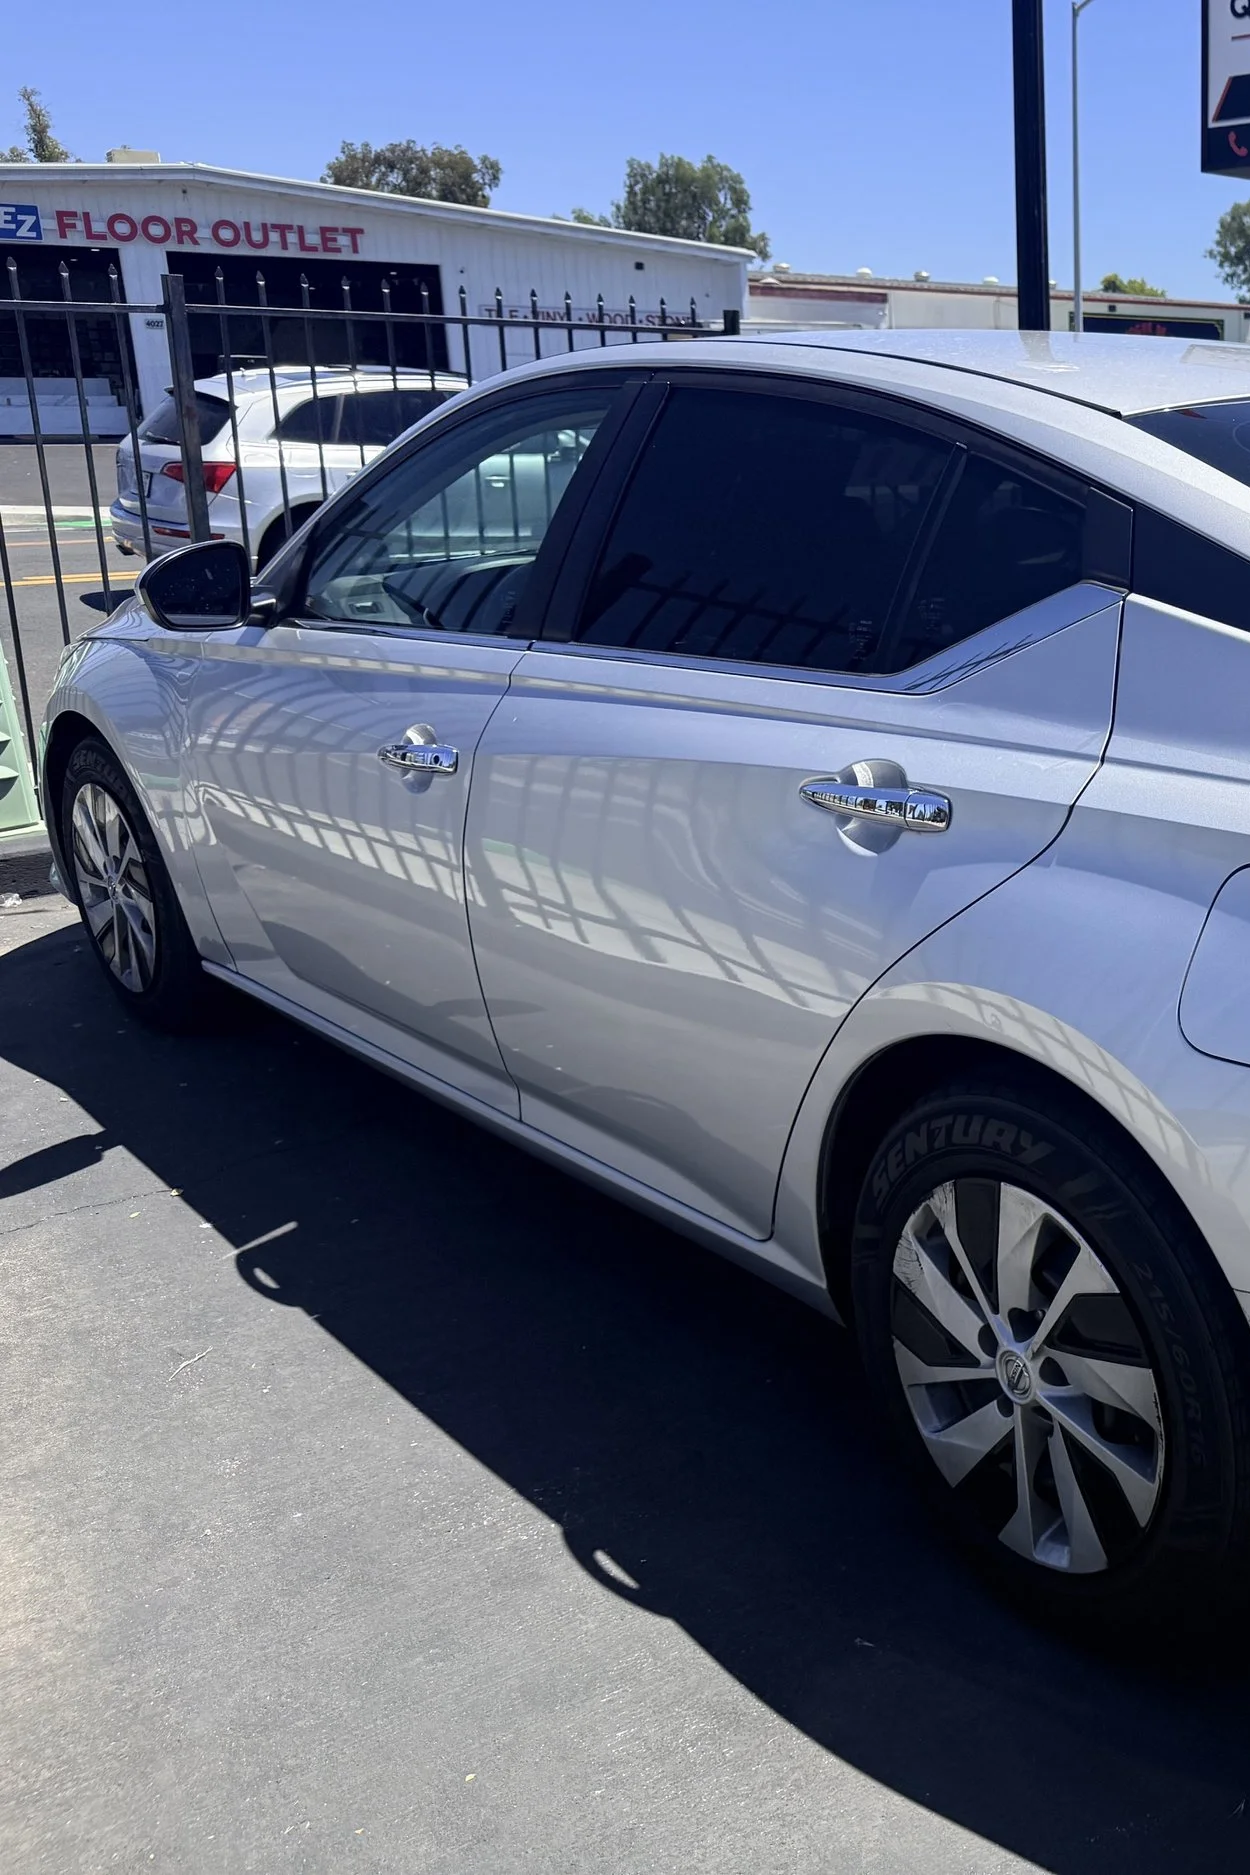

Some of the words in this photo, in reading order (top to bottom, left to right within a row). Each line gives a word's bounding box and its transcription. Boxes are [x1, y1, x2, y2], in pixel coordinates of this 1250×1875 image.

[0, 206, 37, 238] EZ
[55, 210, 200, 246] FLOOR
[211, 218, 365, 255] OUTLET
[872, 1113, 1057, 1201] SENTURY
